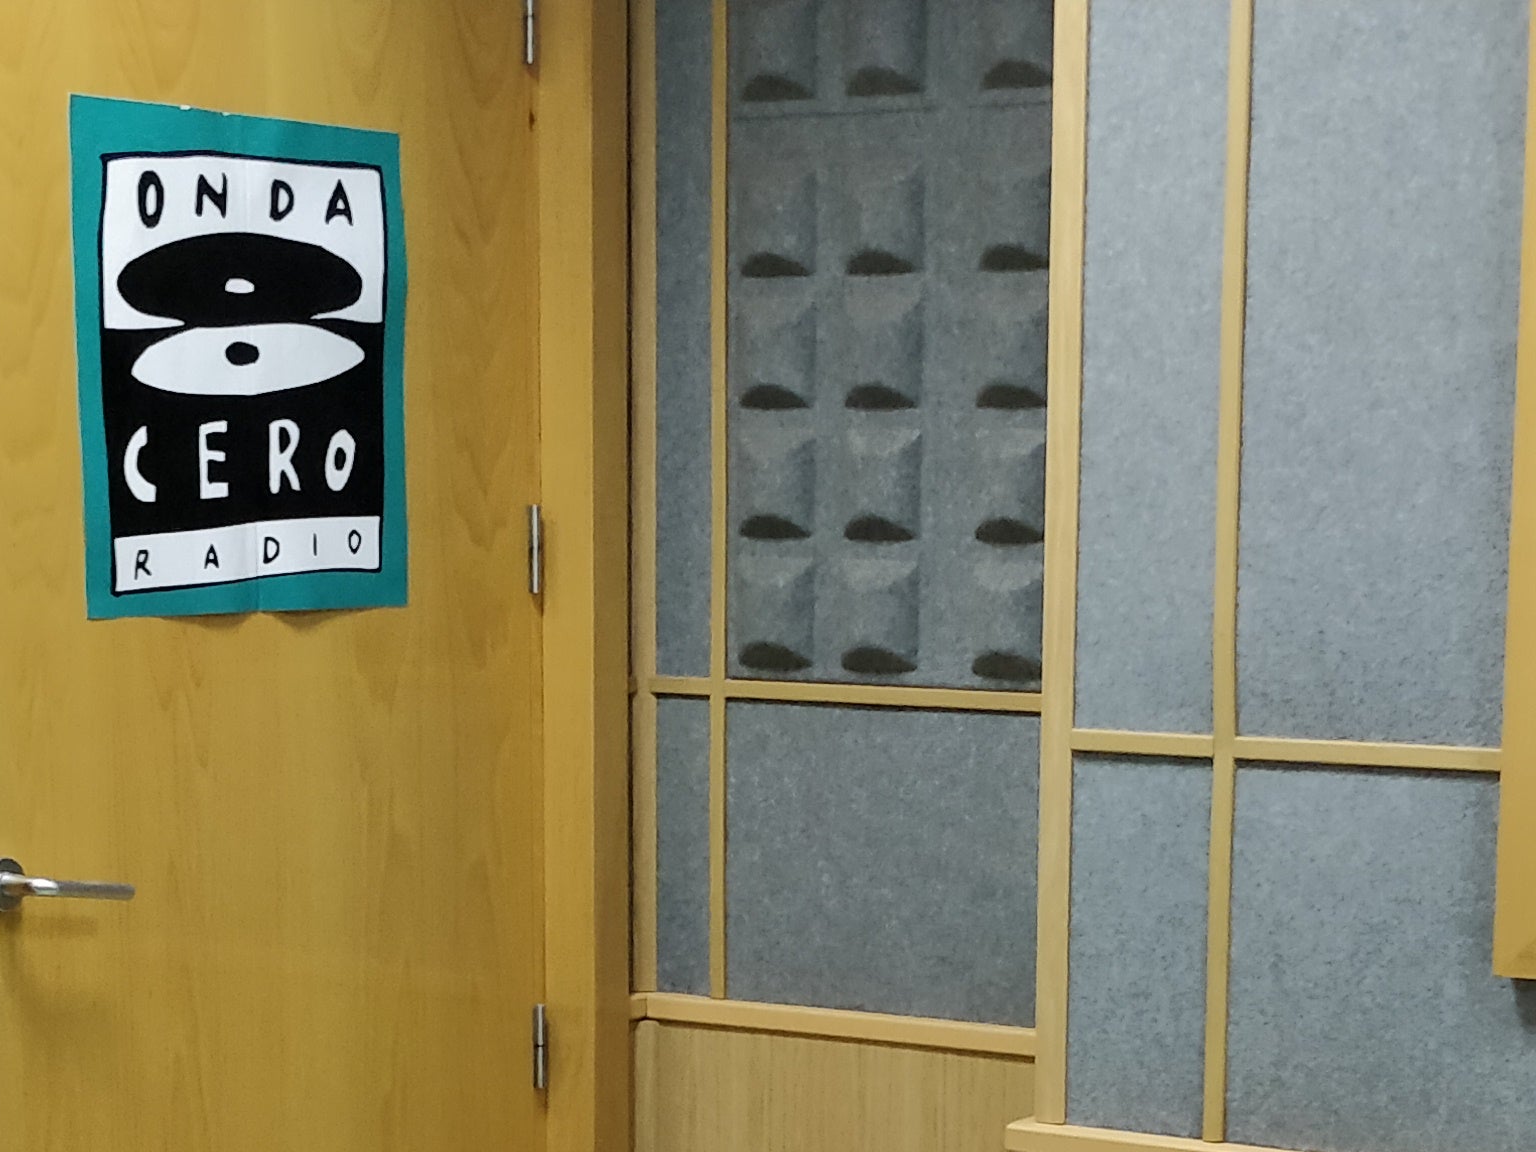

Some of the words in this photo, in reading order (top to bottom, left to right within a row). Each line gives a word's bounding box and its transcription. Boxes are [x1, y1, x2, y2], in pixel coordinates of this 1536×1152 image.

[137, 170, 354, 228] ONDA
[123, 419, 356, 503] CERO
[133, 529, 362, 580] RADIO
